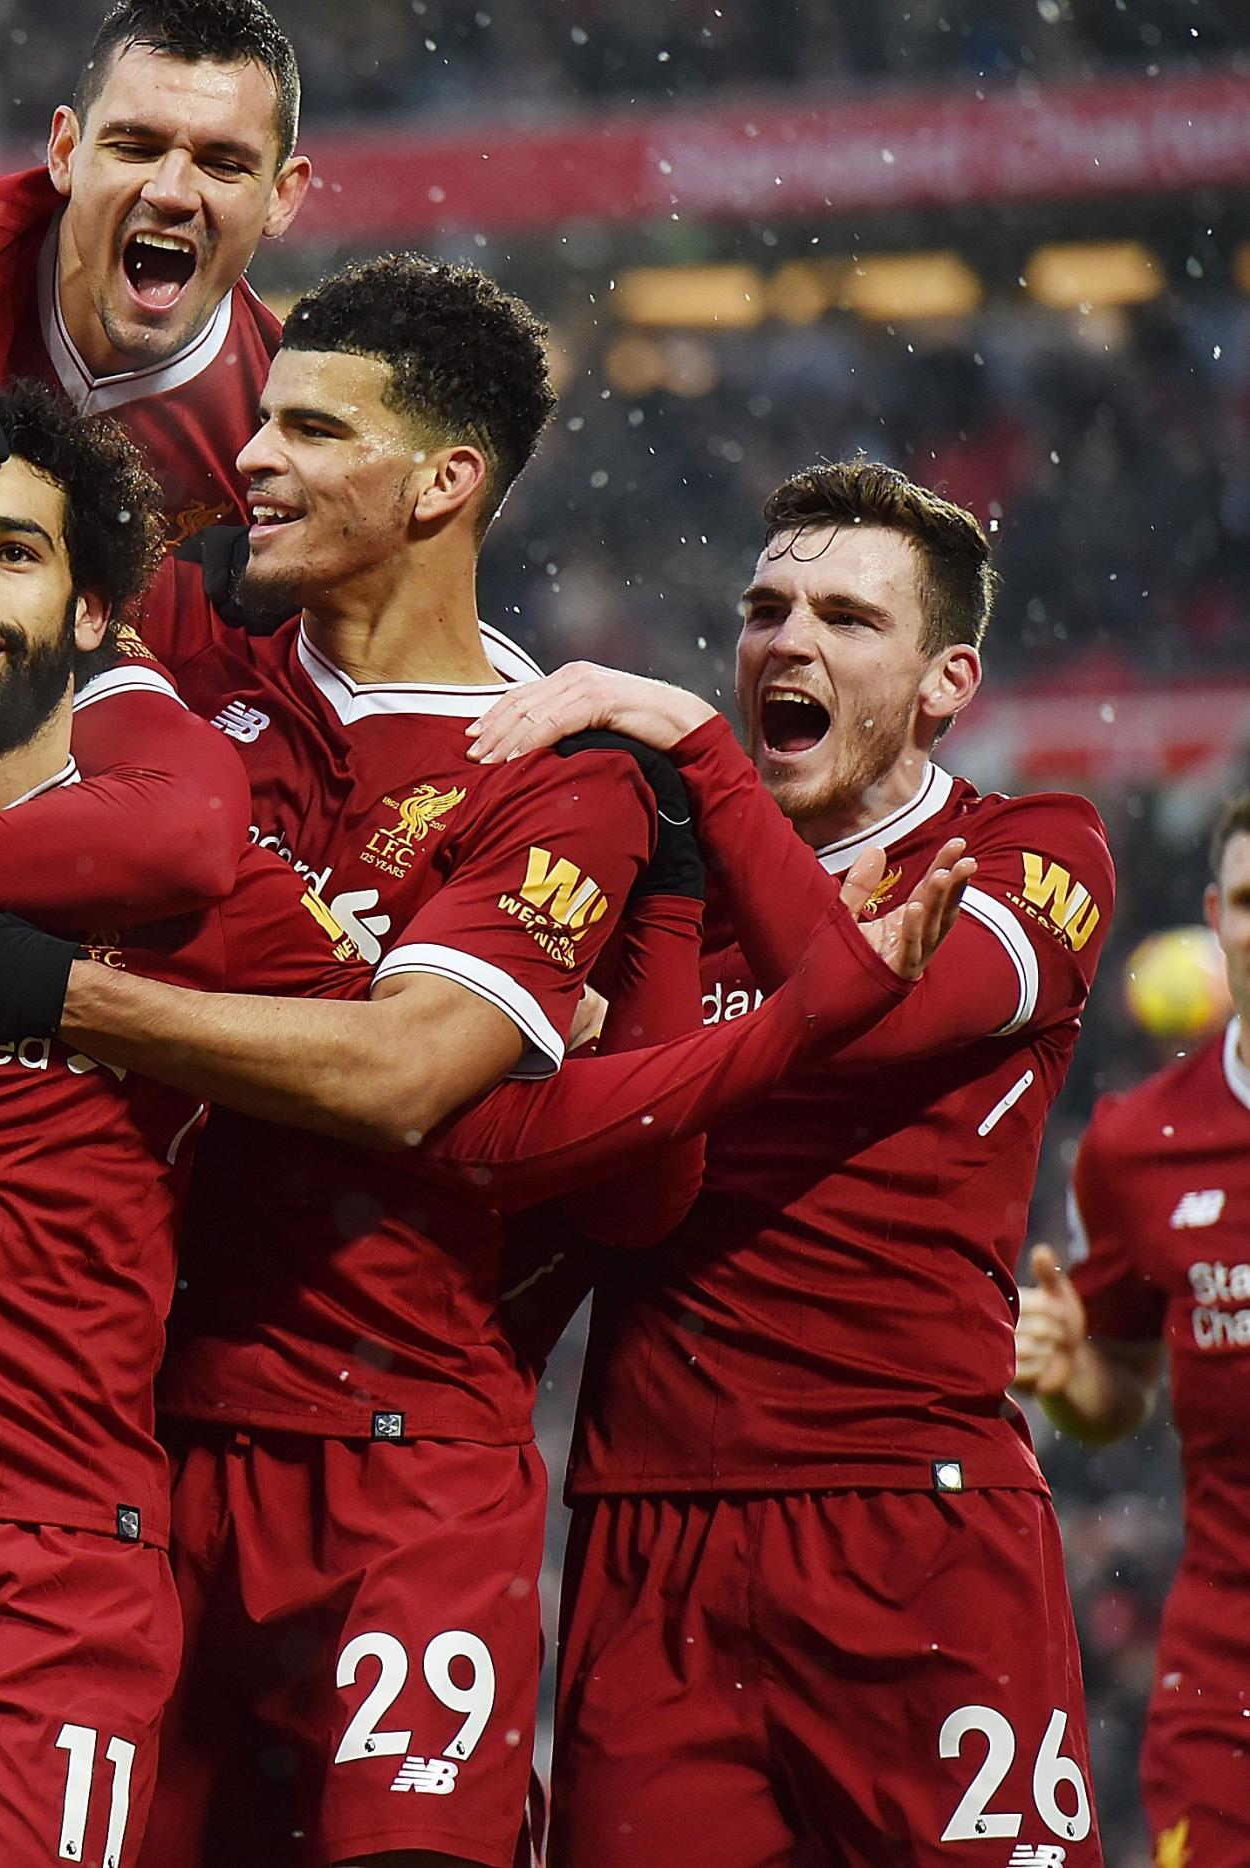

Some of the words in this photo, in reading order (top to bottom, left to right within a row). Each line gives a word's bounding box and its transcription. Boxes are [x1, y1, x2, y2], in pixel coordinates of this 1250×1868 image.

[360, 852, 376, 864] 125
[375, 859, 407, 879] YEARS
[1022, 851, 1100, 952] WU
[335, 1631, 495, 1764] 29
[55, 1723, 136, 1868] 11
[939, 1705, 1091, 1842] 26
